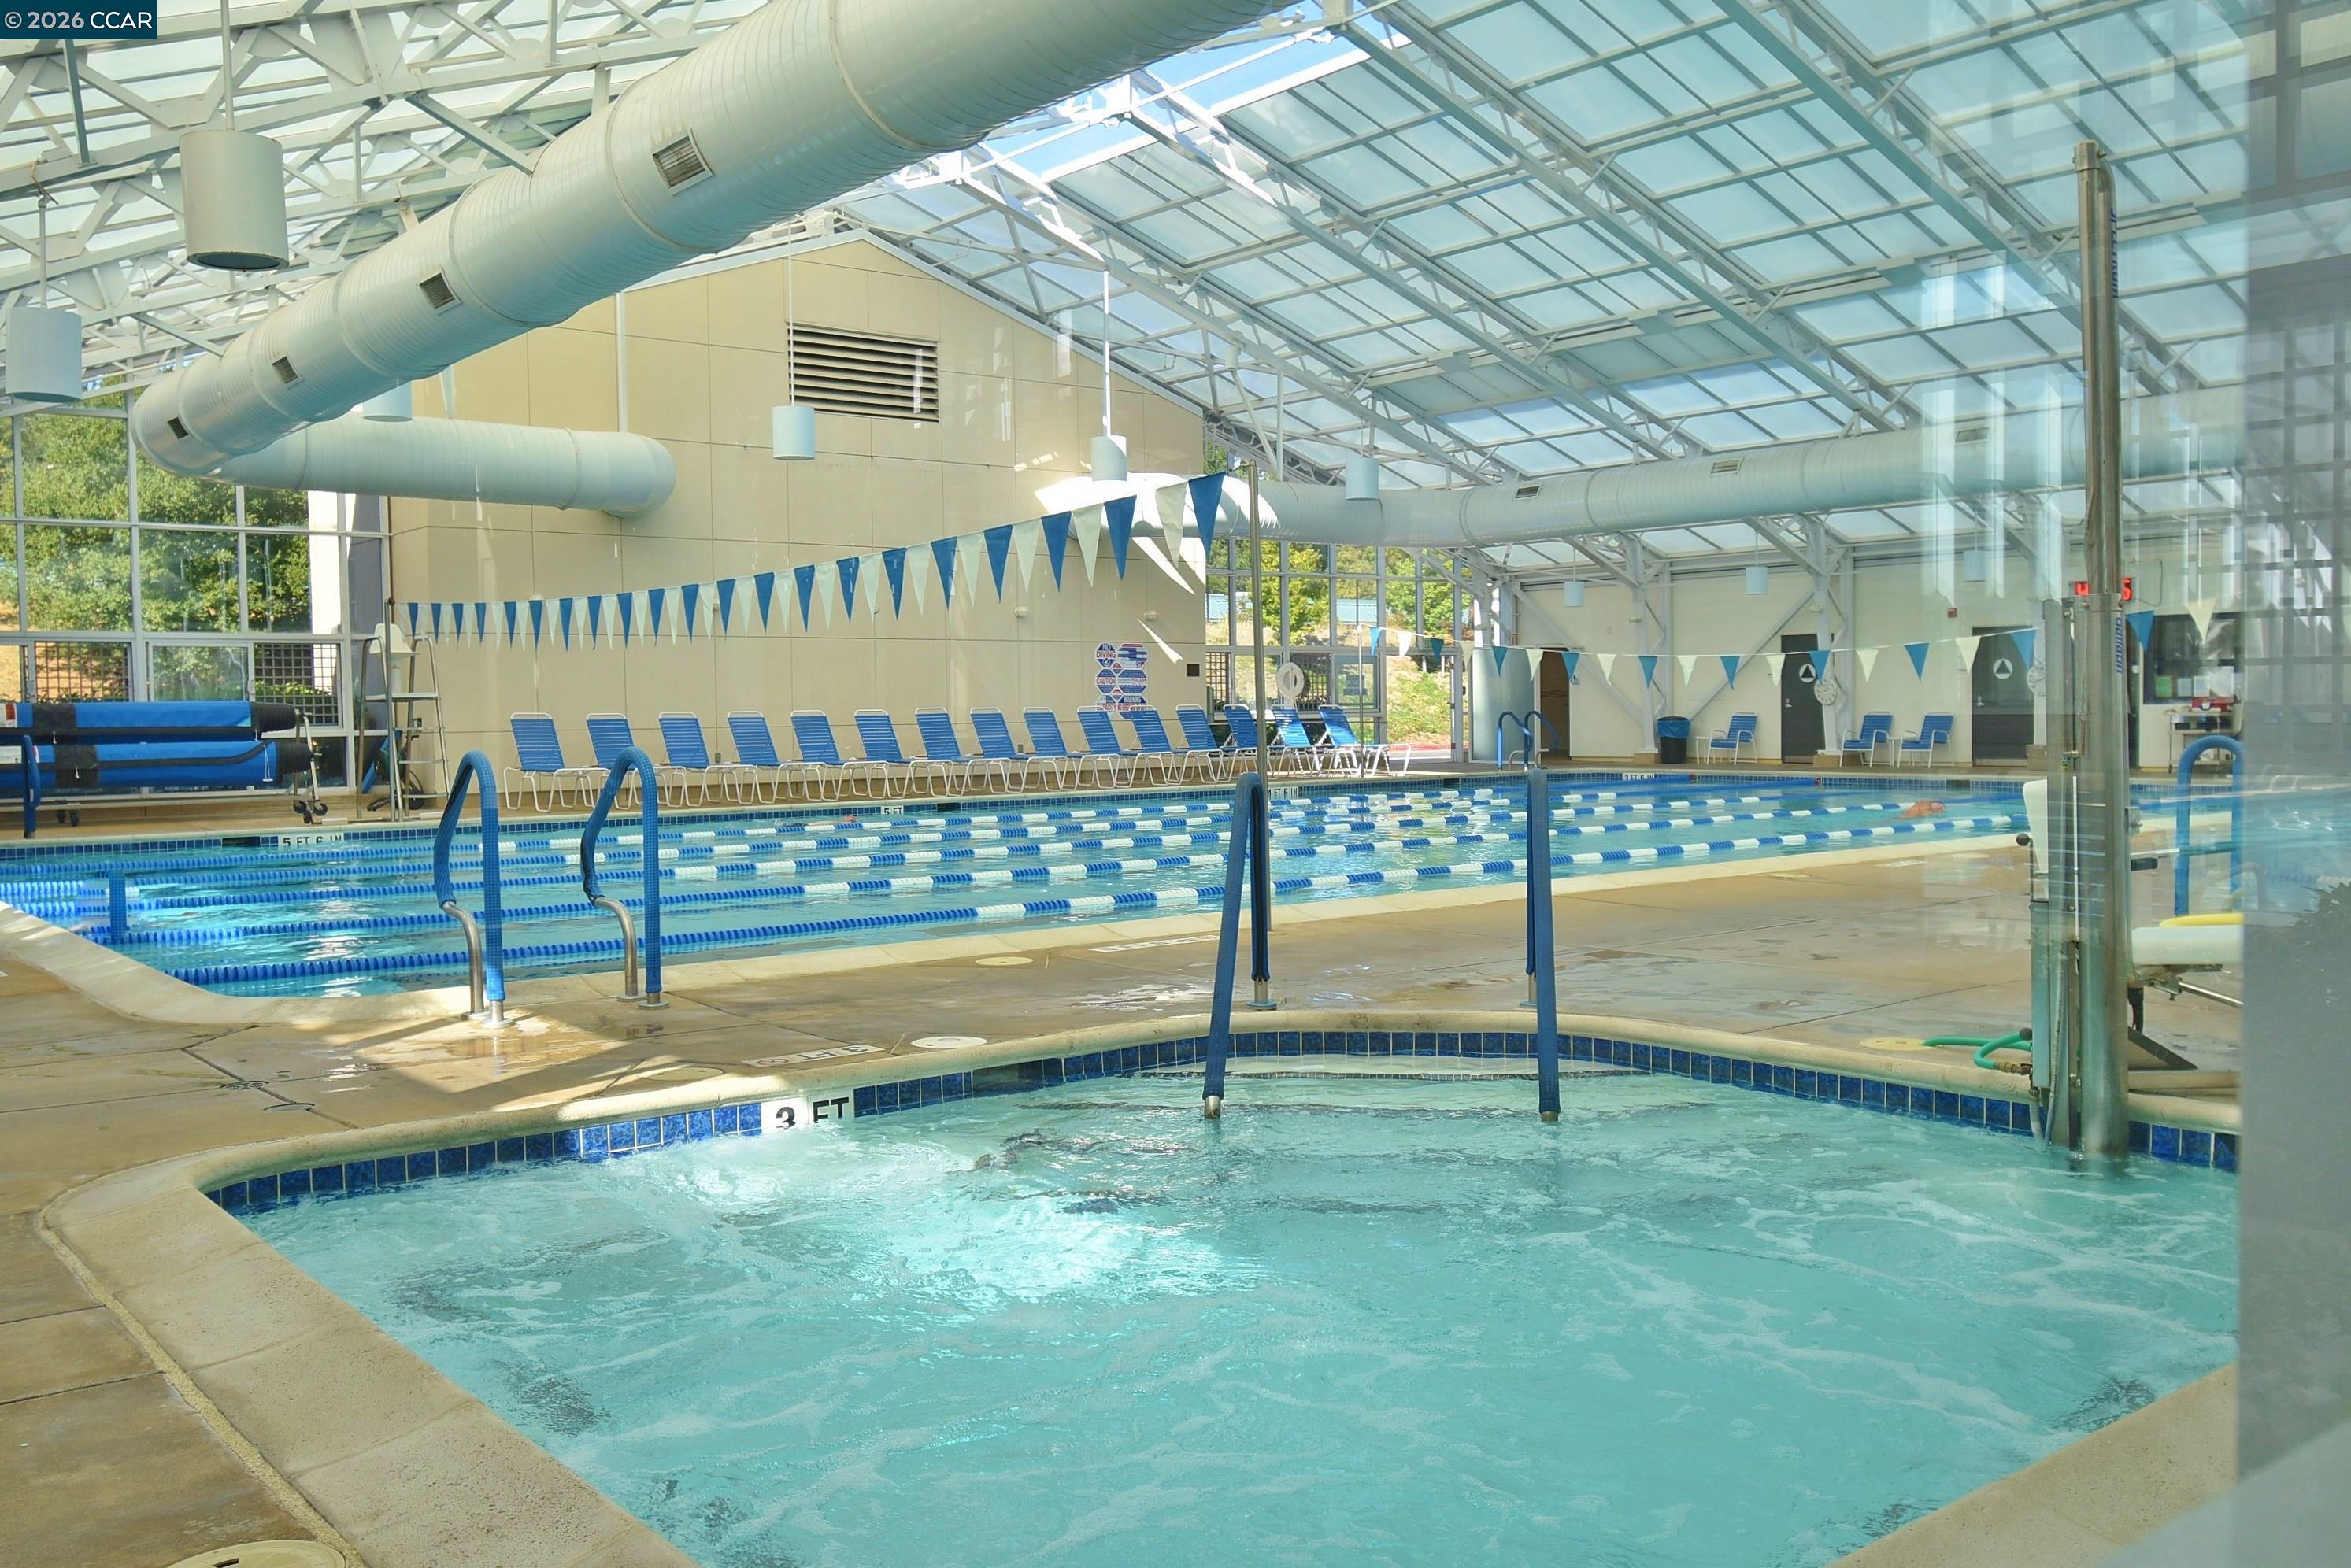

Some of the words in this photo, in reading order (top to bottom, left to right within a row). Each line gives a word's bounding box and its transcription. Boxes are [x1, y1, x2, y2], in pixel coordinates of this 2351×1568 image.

[283, 838, 291, 846] 5
[296, 836, 310, 845] FT
[800, 1051, 836, 1060] FT
[776, 1106, 795, 1129] 3
[813, 1096, 850, 1124] FT
